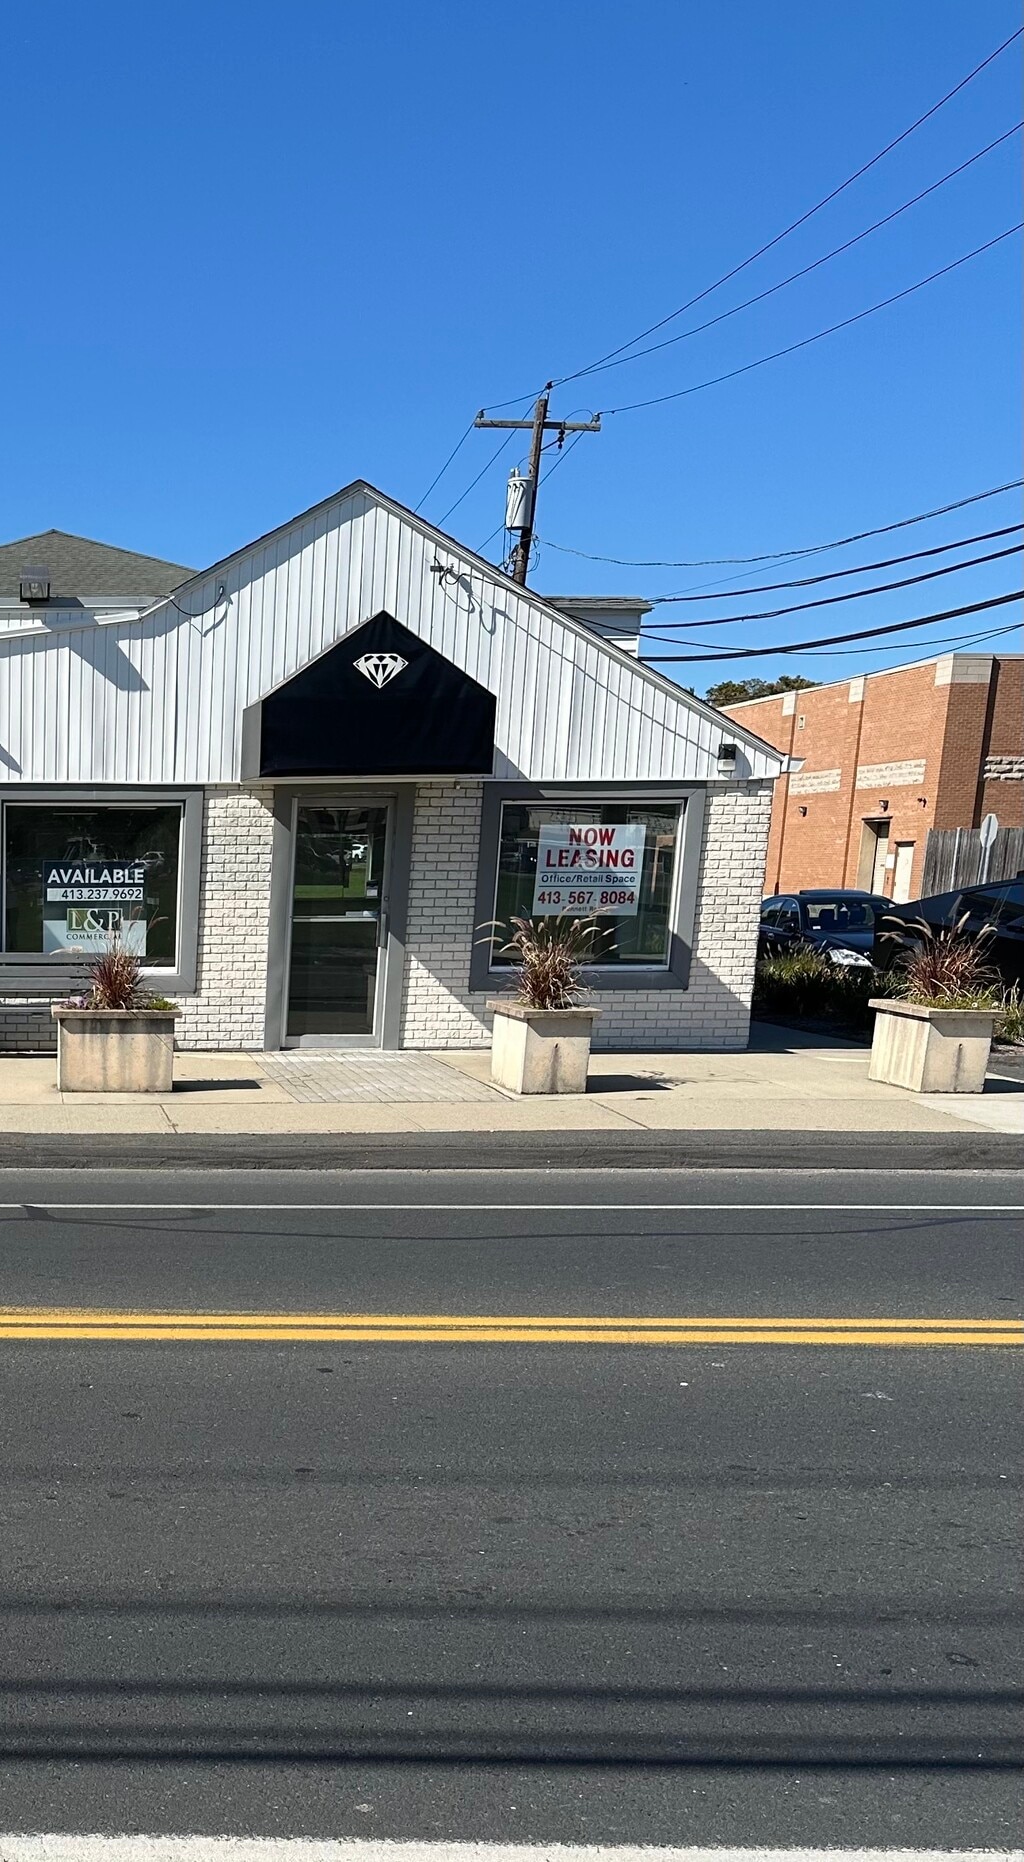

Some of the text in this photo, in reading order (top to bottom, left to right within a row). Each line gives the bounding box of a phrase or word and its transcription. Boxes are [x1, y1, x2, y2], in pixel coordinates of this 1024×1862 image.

[569, 828, 616, 846] NOW
[546, 849, 635, 868] LEASING
[47, 868, 145, 884] AVAILABLE
[541, 875, 636, 884] Office/Retail Space
[61, 889, 142, 900] 413.237.9692
